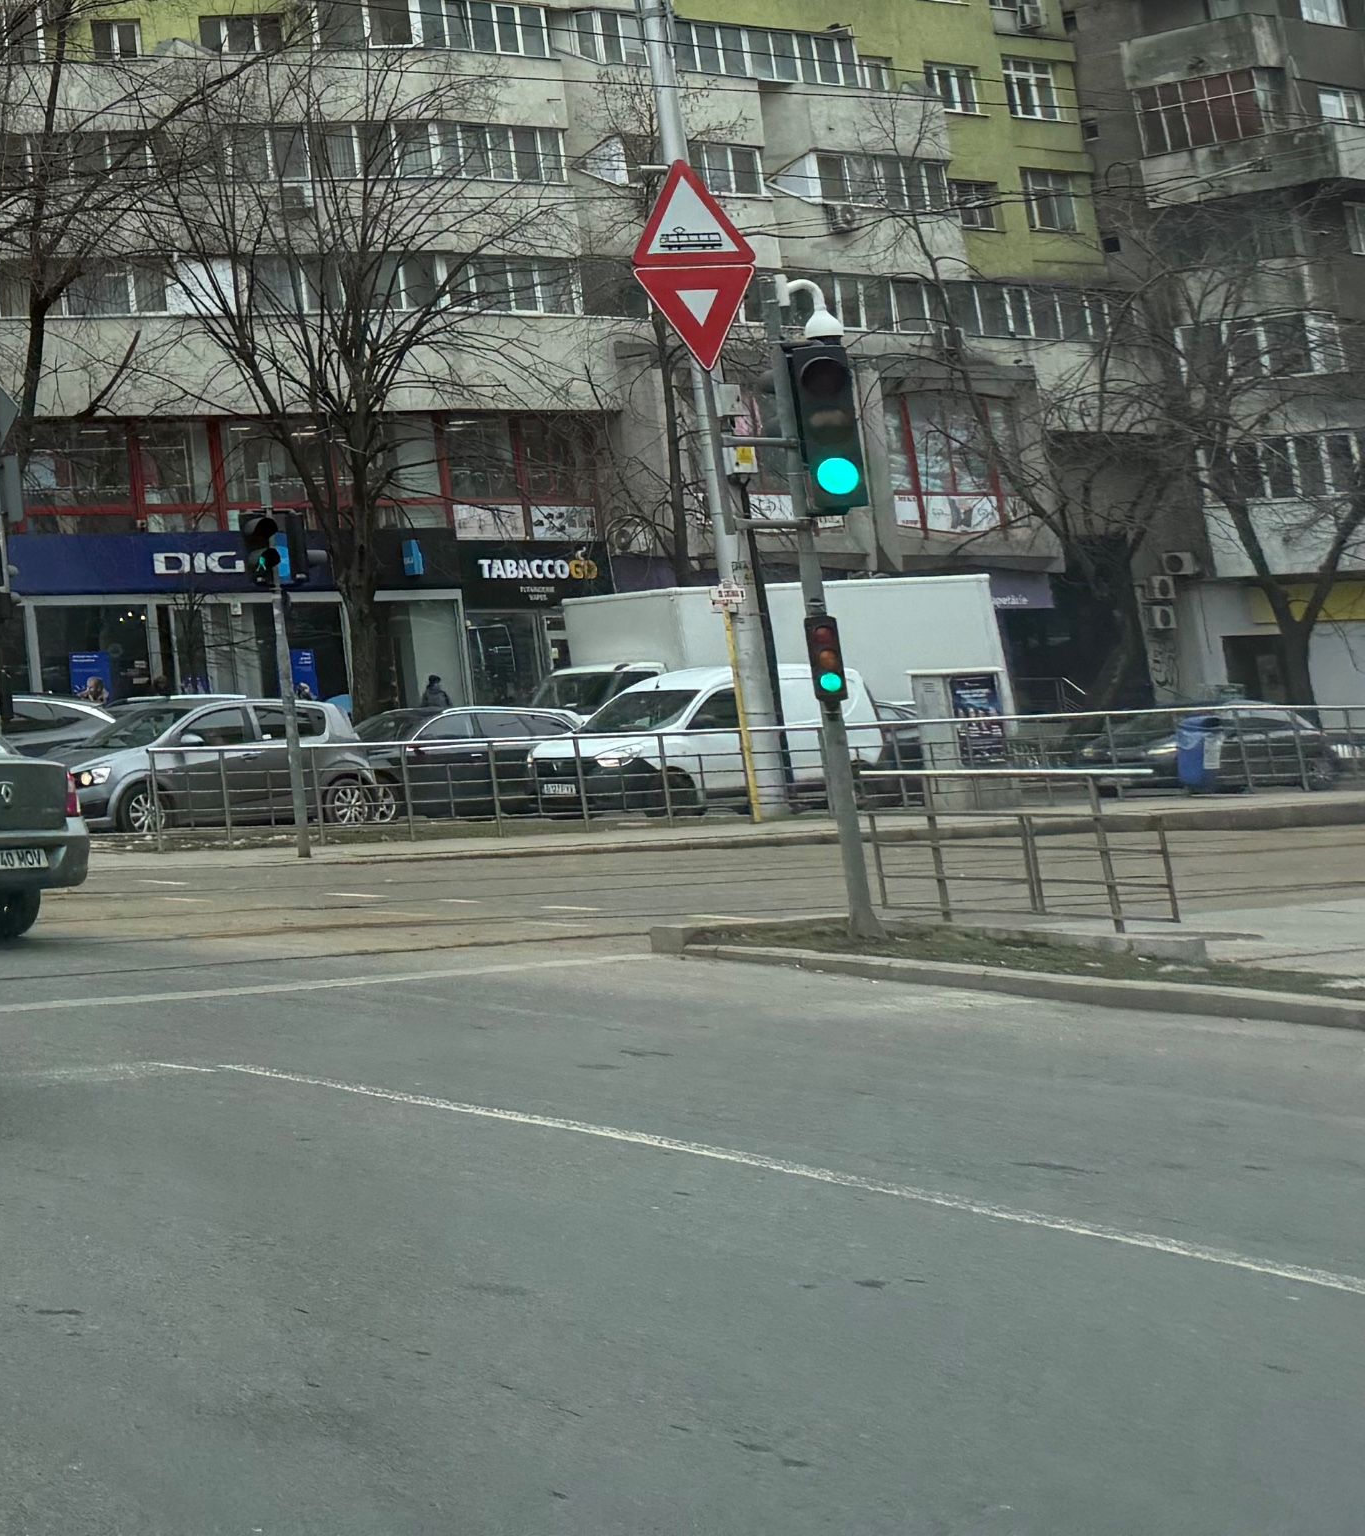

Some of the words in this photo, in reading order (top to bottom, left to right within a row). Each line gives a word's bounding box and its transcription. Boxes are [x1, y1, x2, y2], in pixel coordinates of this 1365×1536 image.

[153, 551, 246, 574] DIG
[0, 851, 15, 867] 40
[16, 849, 41, 866] MOV
